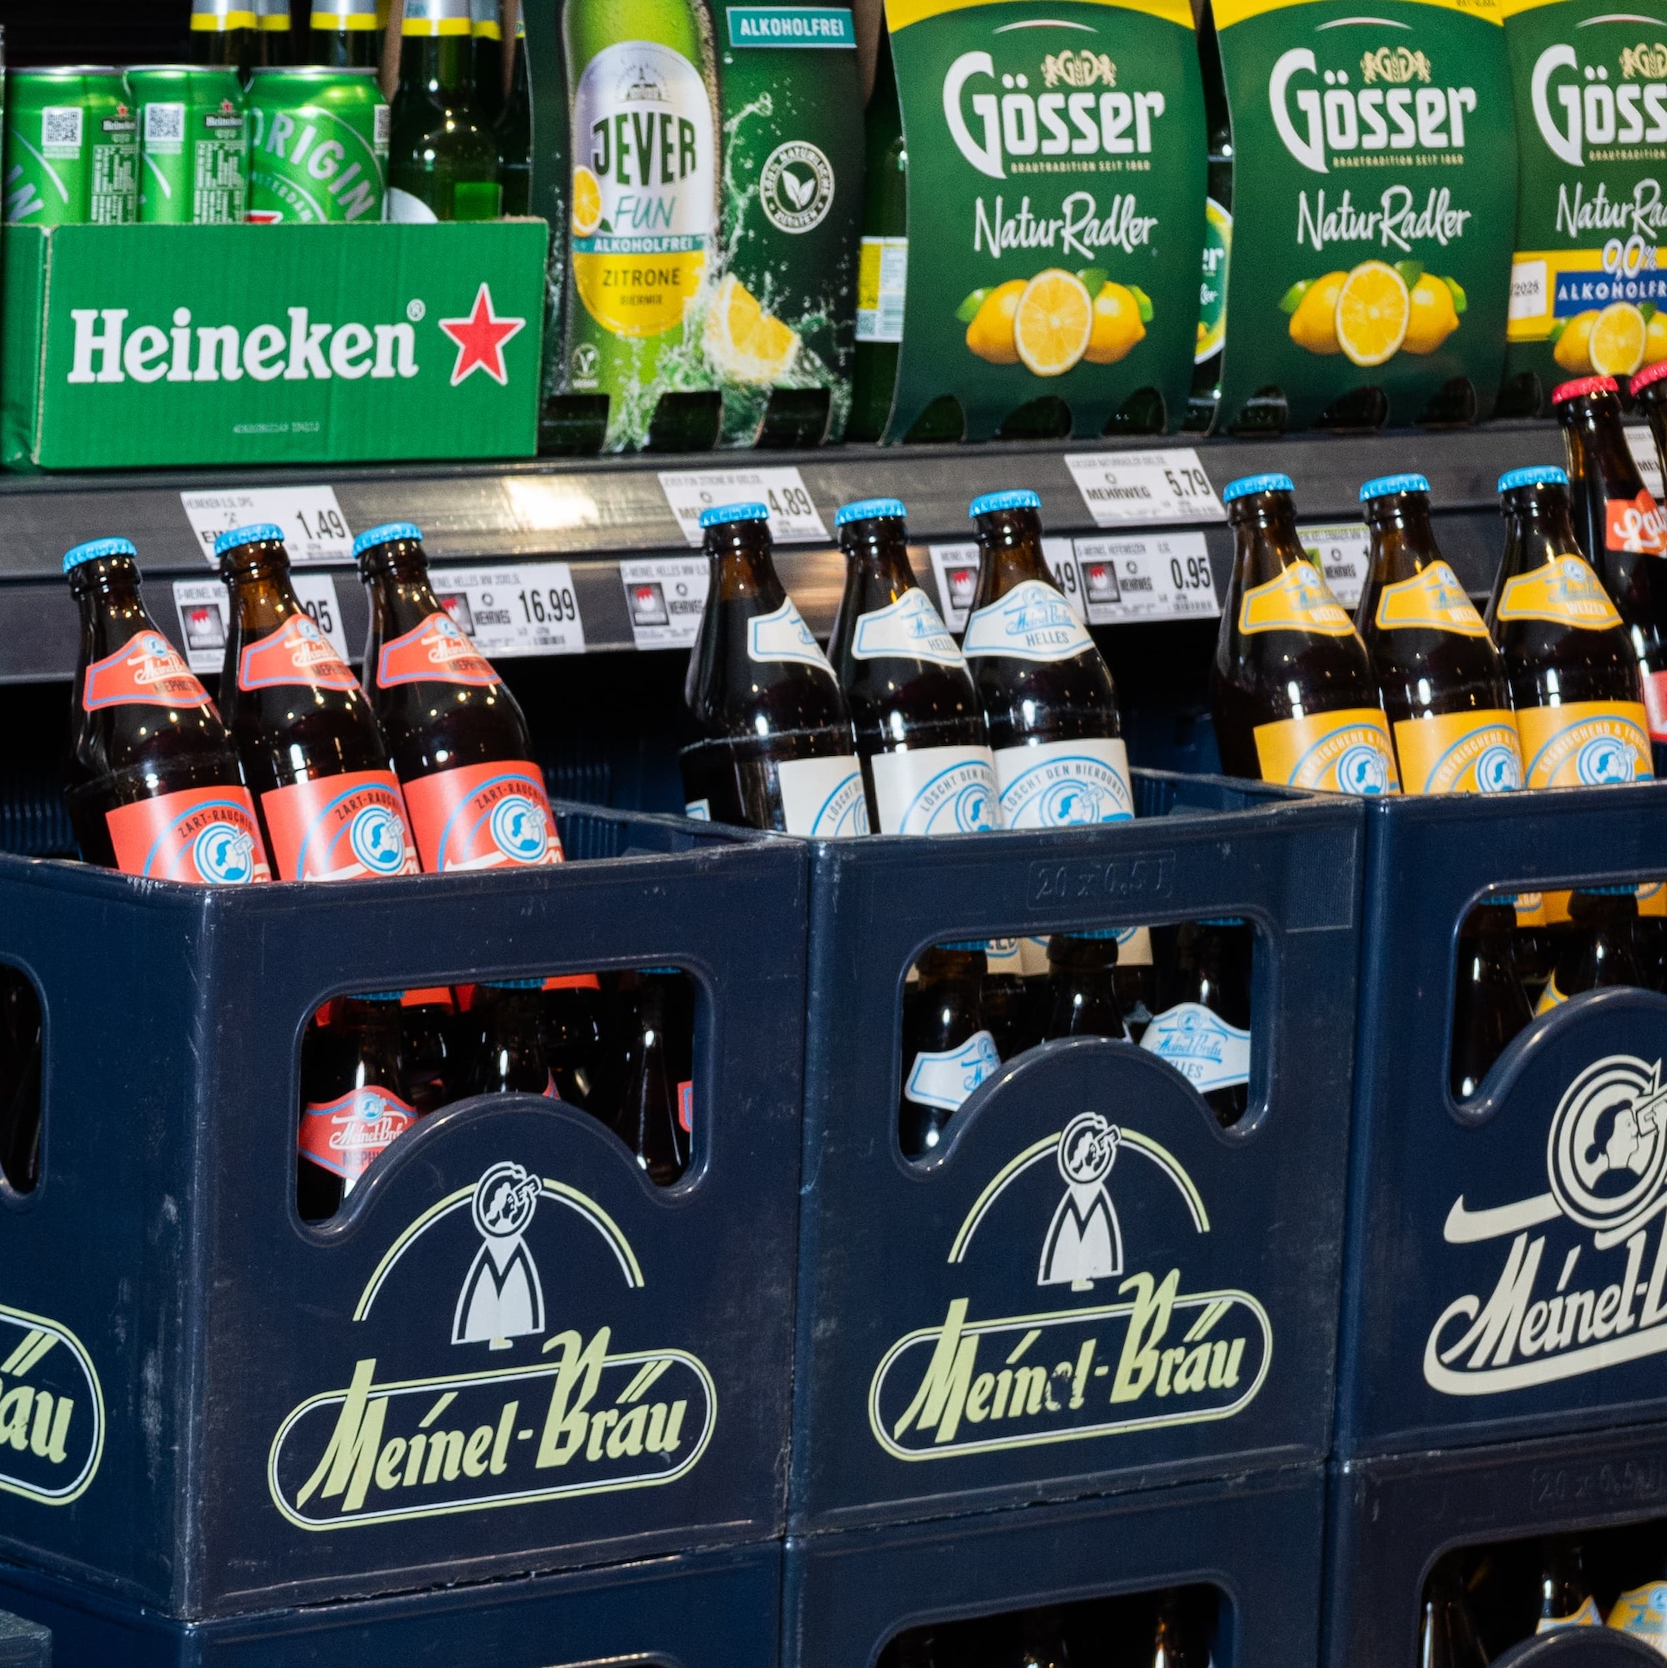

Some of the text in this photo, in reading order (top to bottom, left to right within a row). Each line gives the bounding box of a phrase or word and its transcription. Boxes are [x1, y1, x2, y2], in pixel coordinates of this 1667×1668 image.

[739, 17, 846, 38] ALKOHOLFREI
[592, 111, 698, 187] JEVER
[1414, 155, 1438, 167] SEIT
[1098, 160, 1122, 171] SEIT
[613, 194, 676, 230] FUN
[593, 234, 694, 253] ALKOHOLFREI
[602, 267, 682, 287] ZITRONE
[66, 305, 419, 384] Heineken
[1085, 485, 1152, 501] MEHRWEG
[1162, 468, 1211, 498] 5.79
[766, 487, 814, 517] 4.89
[296, 509, 346, 541] 1.49
[1170, 557, 1212, 590] 0.95
[518, 588, 576, 624] 16.99
[1025, 630, 1070, 649] HELLES
[1046, 763, 1071, 781] DEN
[919, 773, 959, 813] LÖSCHT
